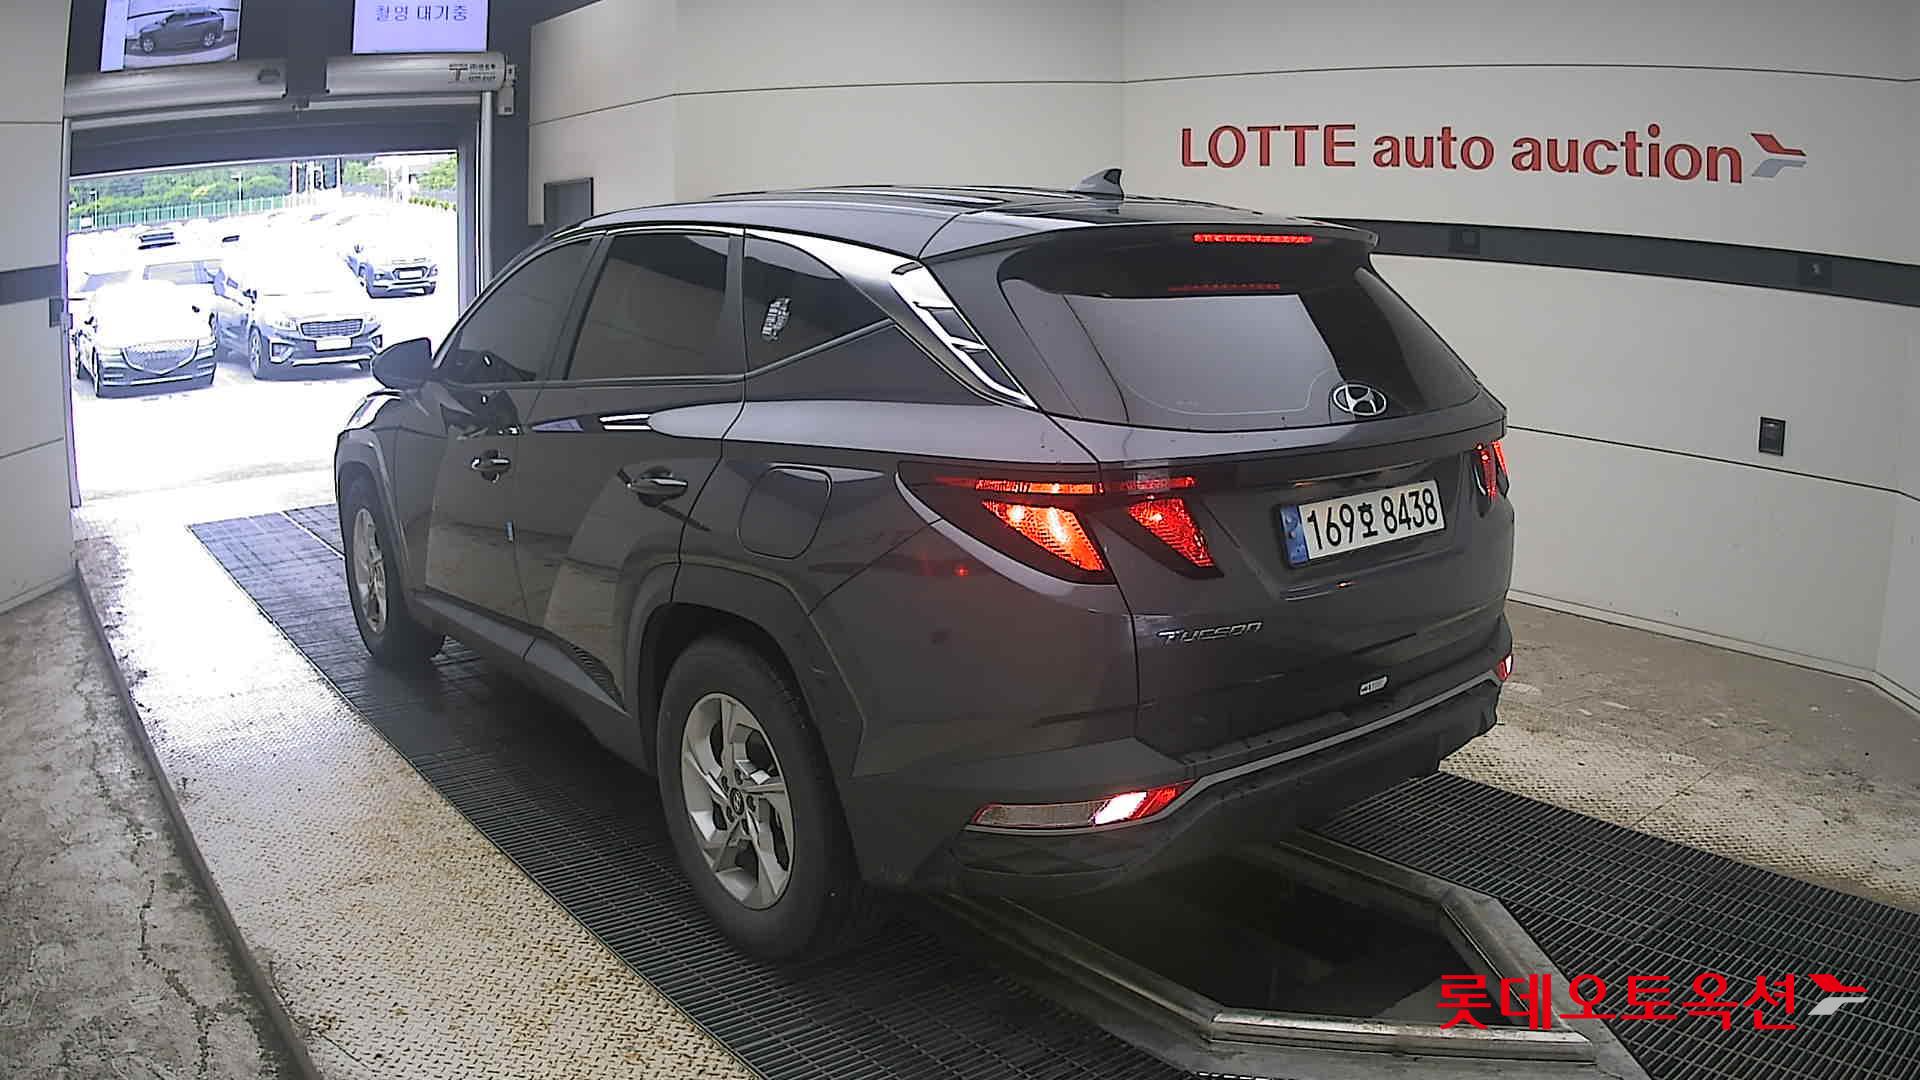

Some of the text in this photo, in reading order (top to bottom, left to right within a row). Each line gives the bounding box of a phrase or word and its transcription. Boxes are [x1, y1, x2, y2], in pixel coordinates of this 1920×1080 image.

[1181, 123, 1743, 184] LOTTE auto auction
[1307, 488, 1438, 550] 169호 8438
